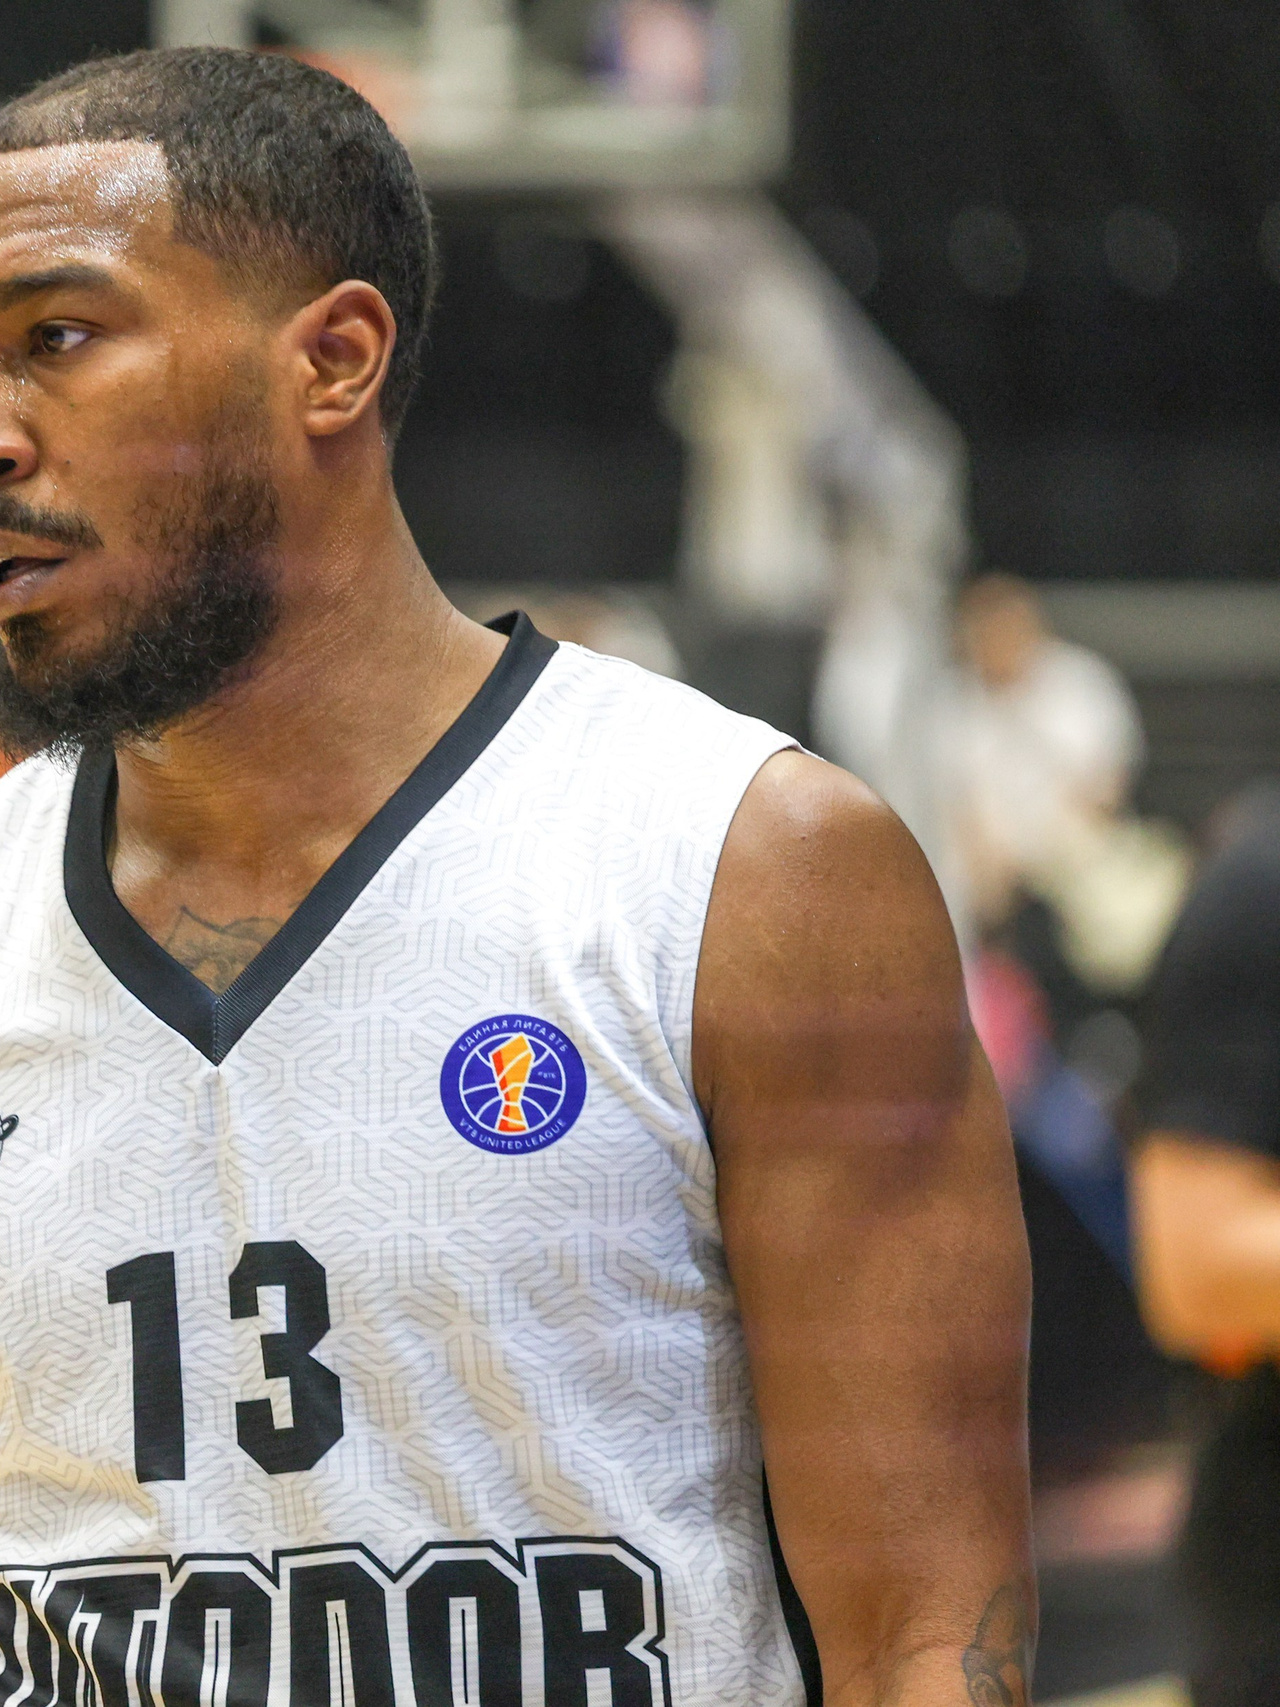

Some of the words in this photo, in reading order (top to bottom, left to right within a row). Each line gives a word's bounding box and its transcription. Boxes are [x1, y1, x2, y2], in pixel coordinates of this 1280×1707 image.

[458, 1019, 509, 1052] ЕДИНАЯ
[513, 1019, 547, 1036] ЛИГА
[548, 1033, 569, 1053] ВТБ
[459, 1117, 478, 1138] VTB
[478, 1134, 523, 1150] UNITED
[525, 1118, 568, 1148] LEAGUE
[106, 1240, 345, 1483] 13
